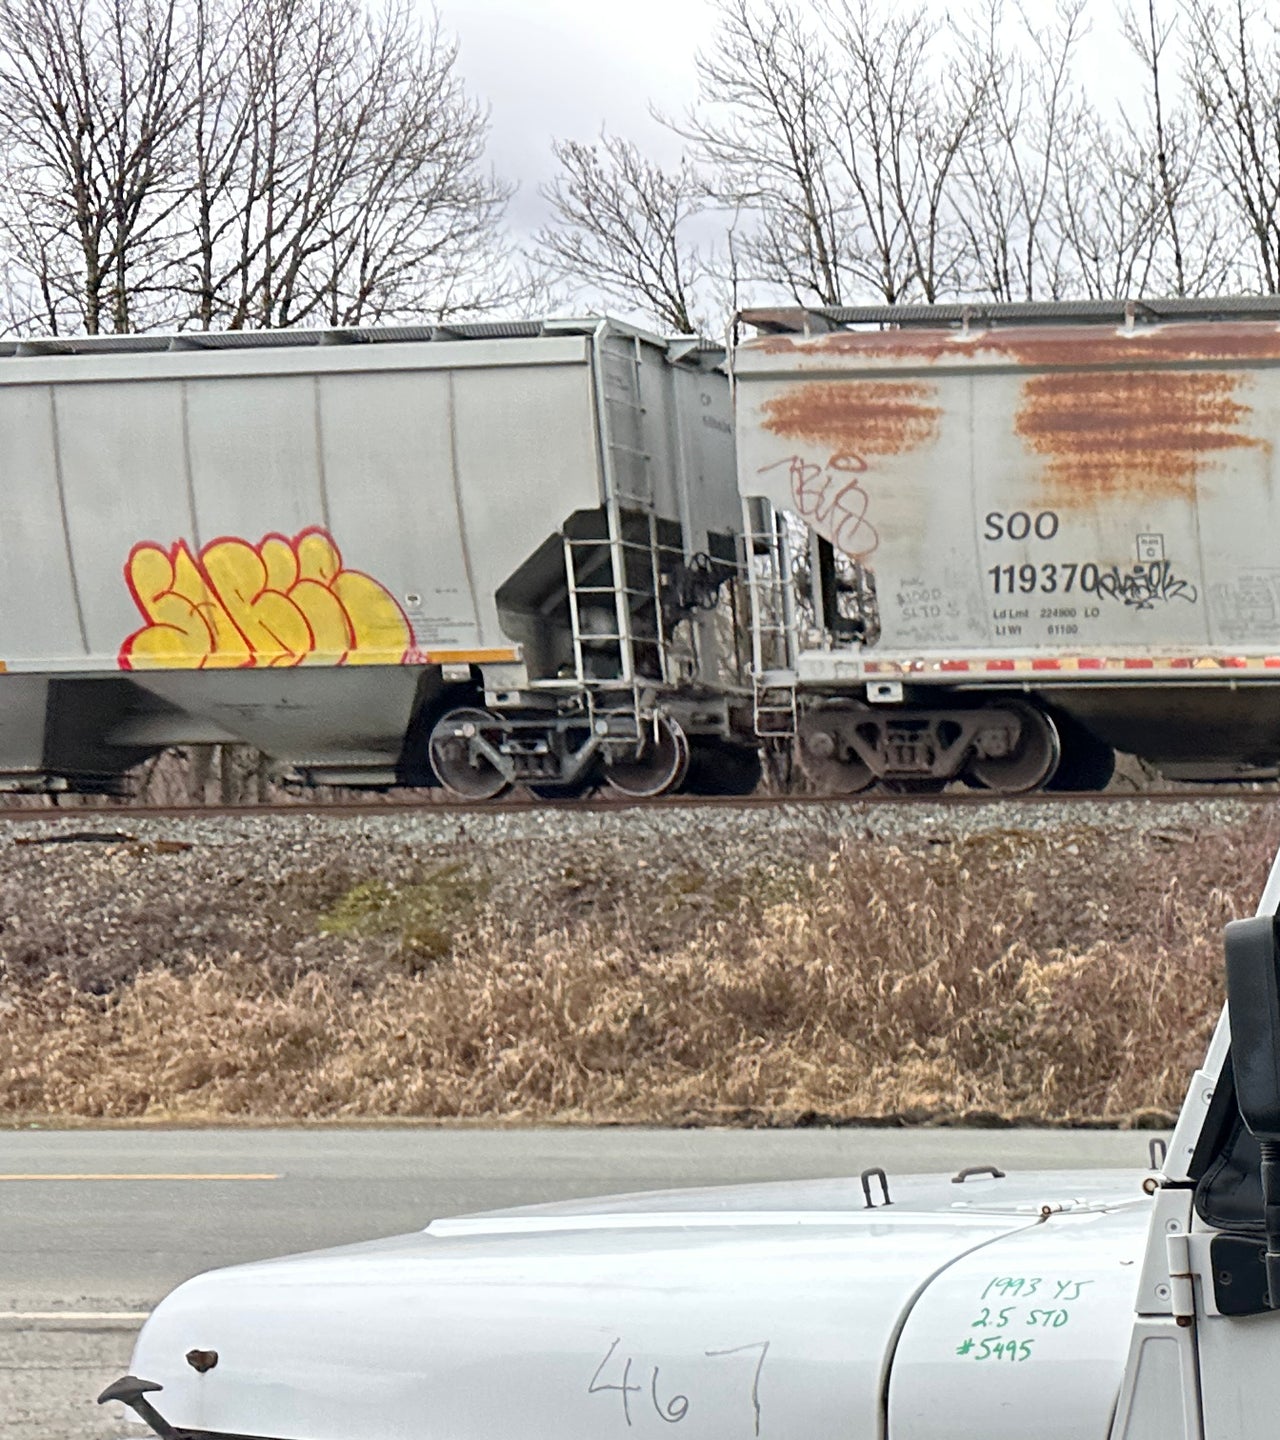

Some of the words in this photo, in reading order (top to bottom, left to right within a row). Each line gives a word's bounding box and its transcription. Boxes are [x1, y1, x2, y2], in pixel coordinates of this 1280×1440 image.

[984, 511, 1060, 541] SOO
[988, 563, 1099, 594] 119370
[981, 1277, 1042, 1300] 1993
[971, 1306, 1017, 1328] 2.5
[1026, 1308, 1069, 1328] STD
[956, 1335, 1035, 1361] #5495
[588, 1337, 770, 1437] 467
